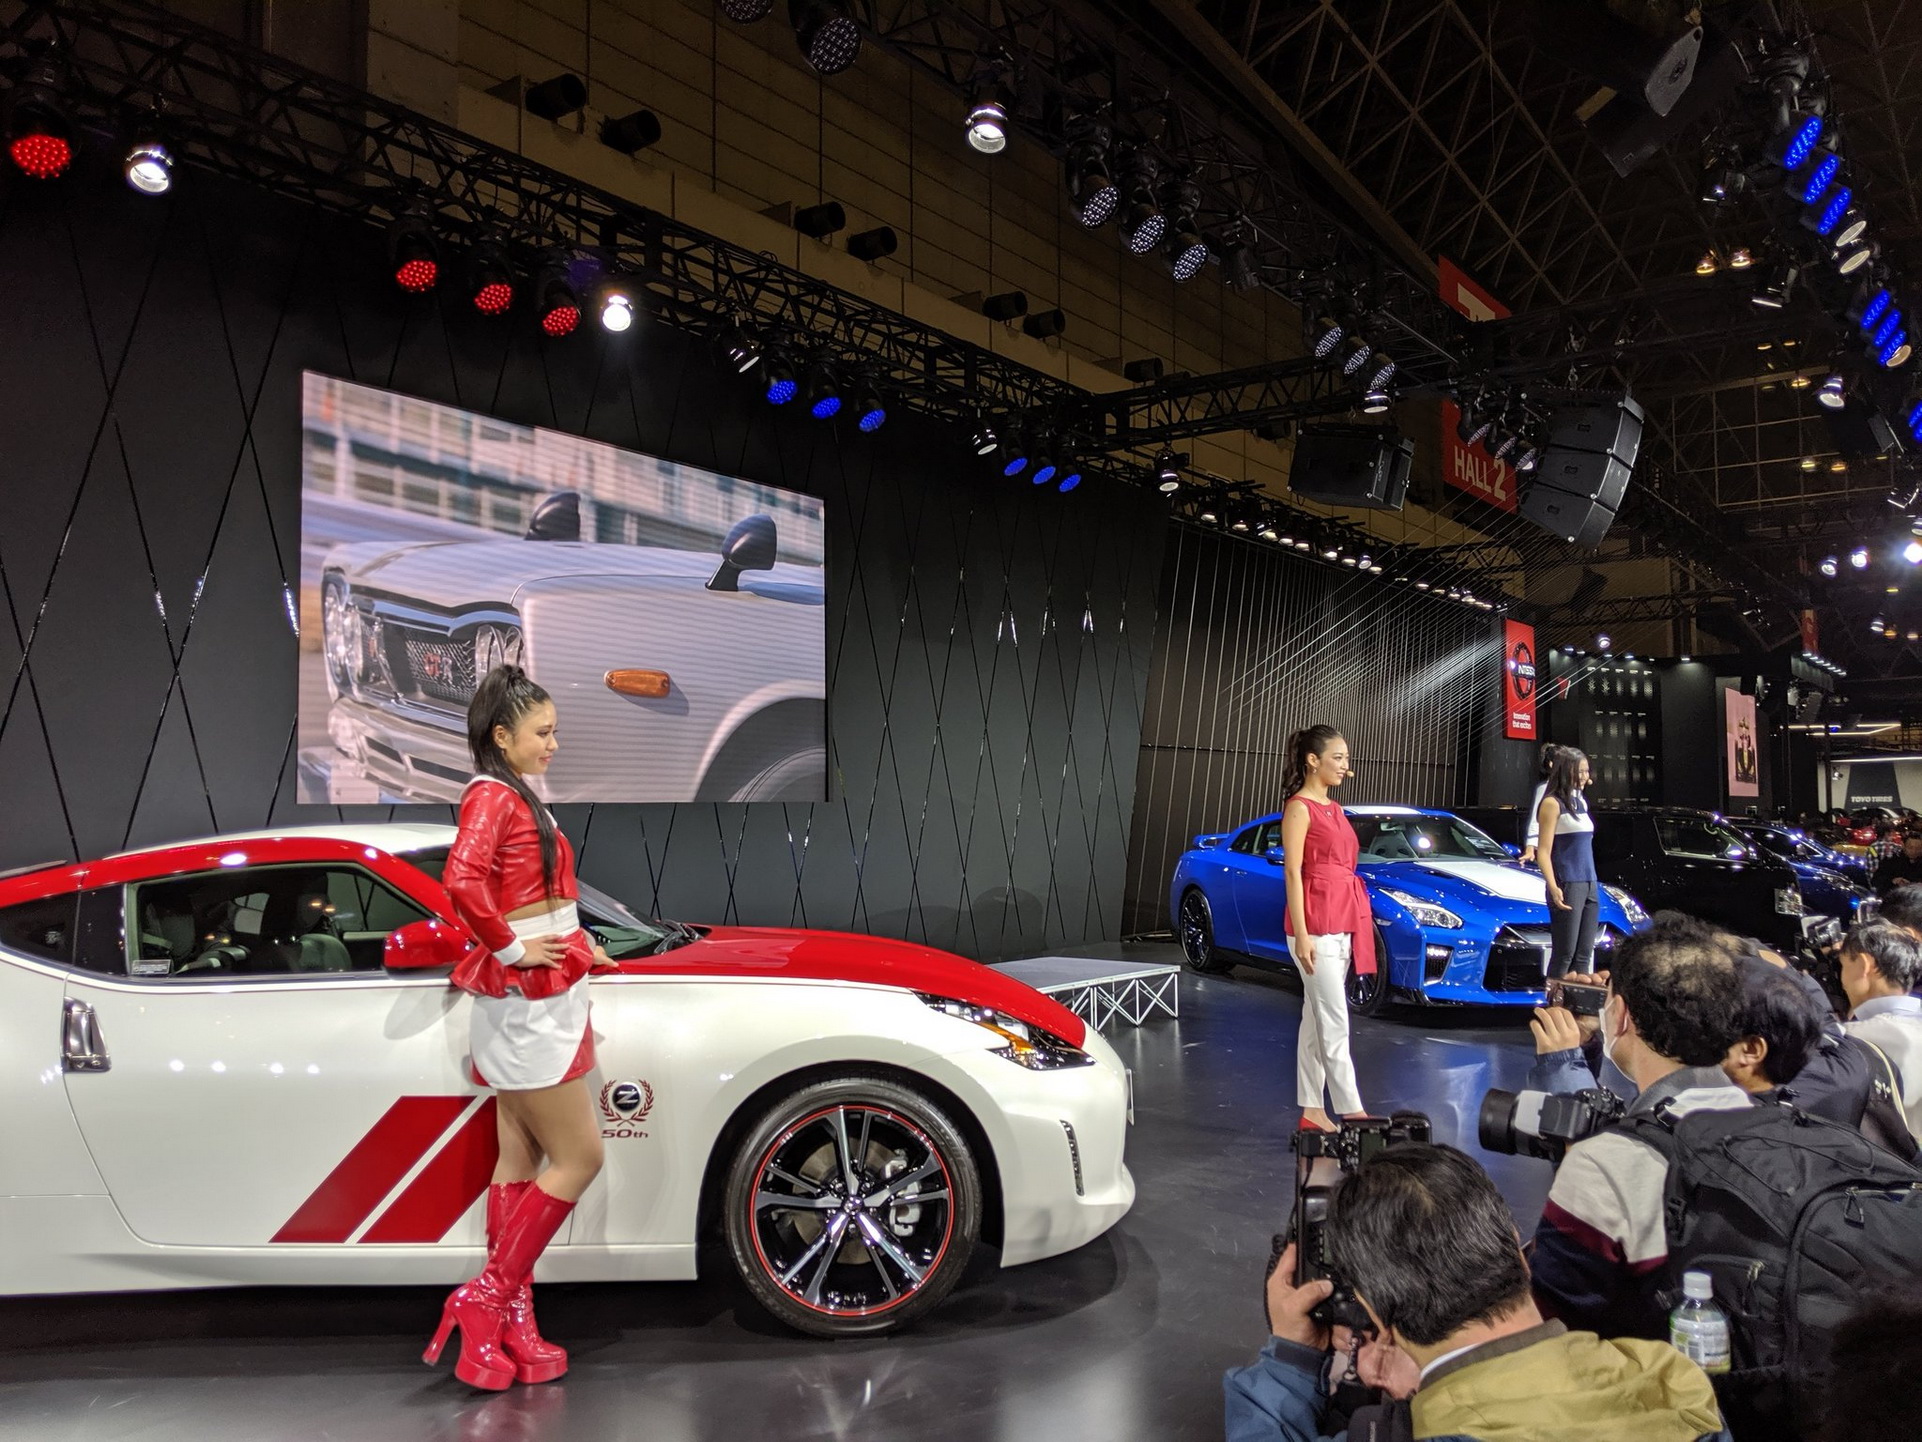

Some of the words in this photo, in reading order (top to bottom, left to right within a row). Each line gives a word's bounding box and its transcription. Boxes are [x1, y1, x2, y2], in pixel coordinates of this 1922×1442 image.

[1454, 445, 1492, 493] HALL
[1493, 457, 1506, 502] 2
[616, 1089, 639, 1105] Z
[601, 1128, 649, 1139] 50th
